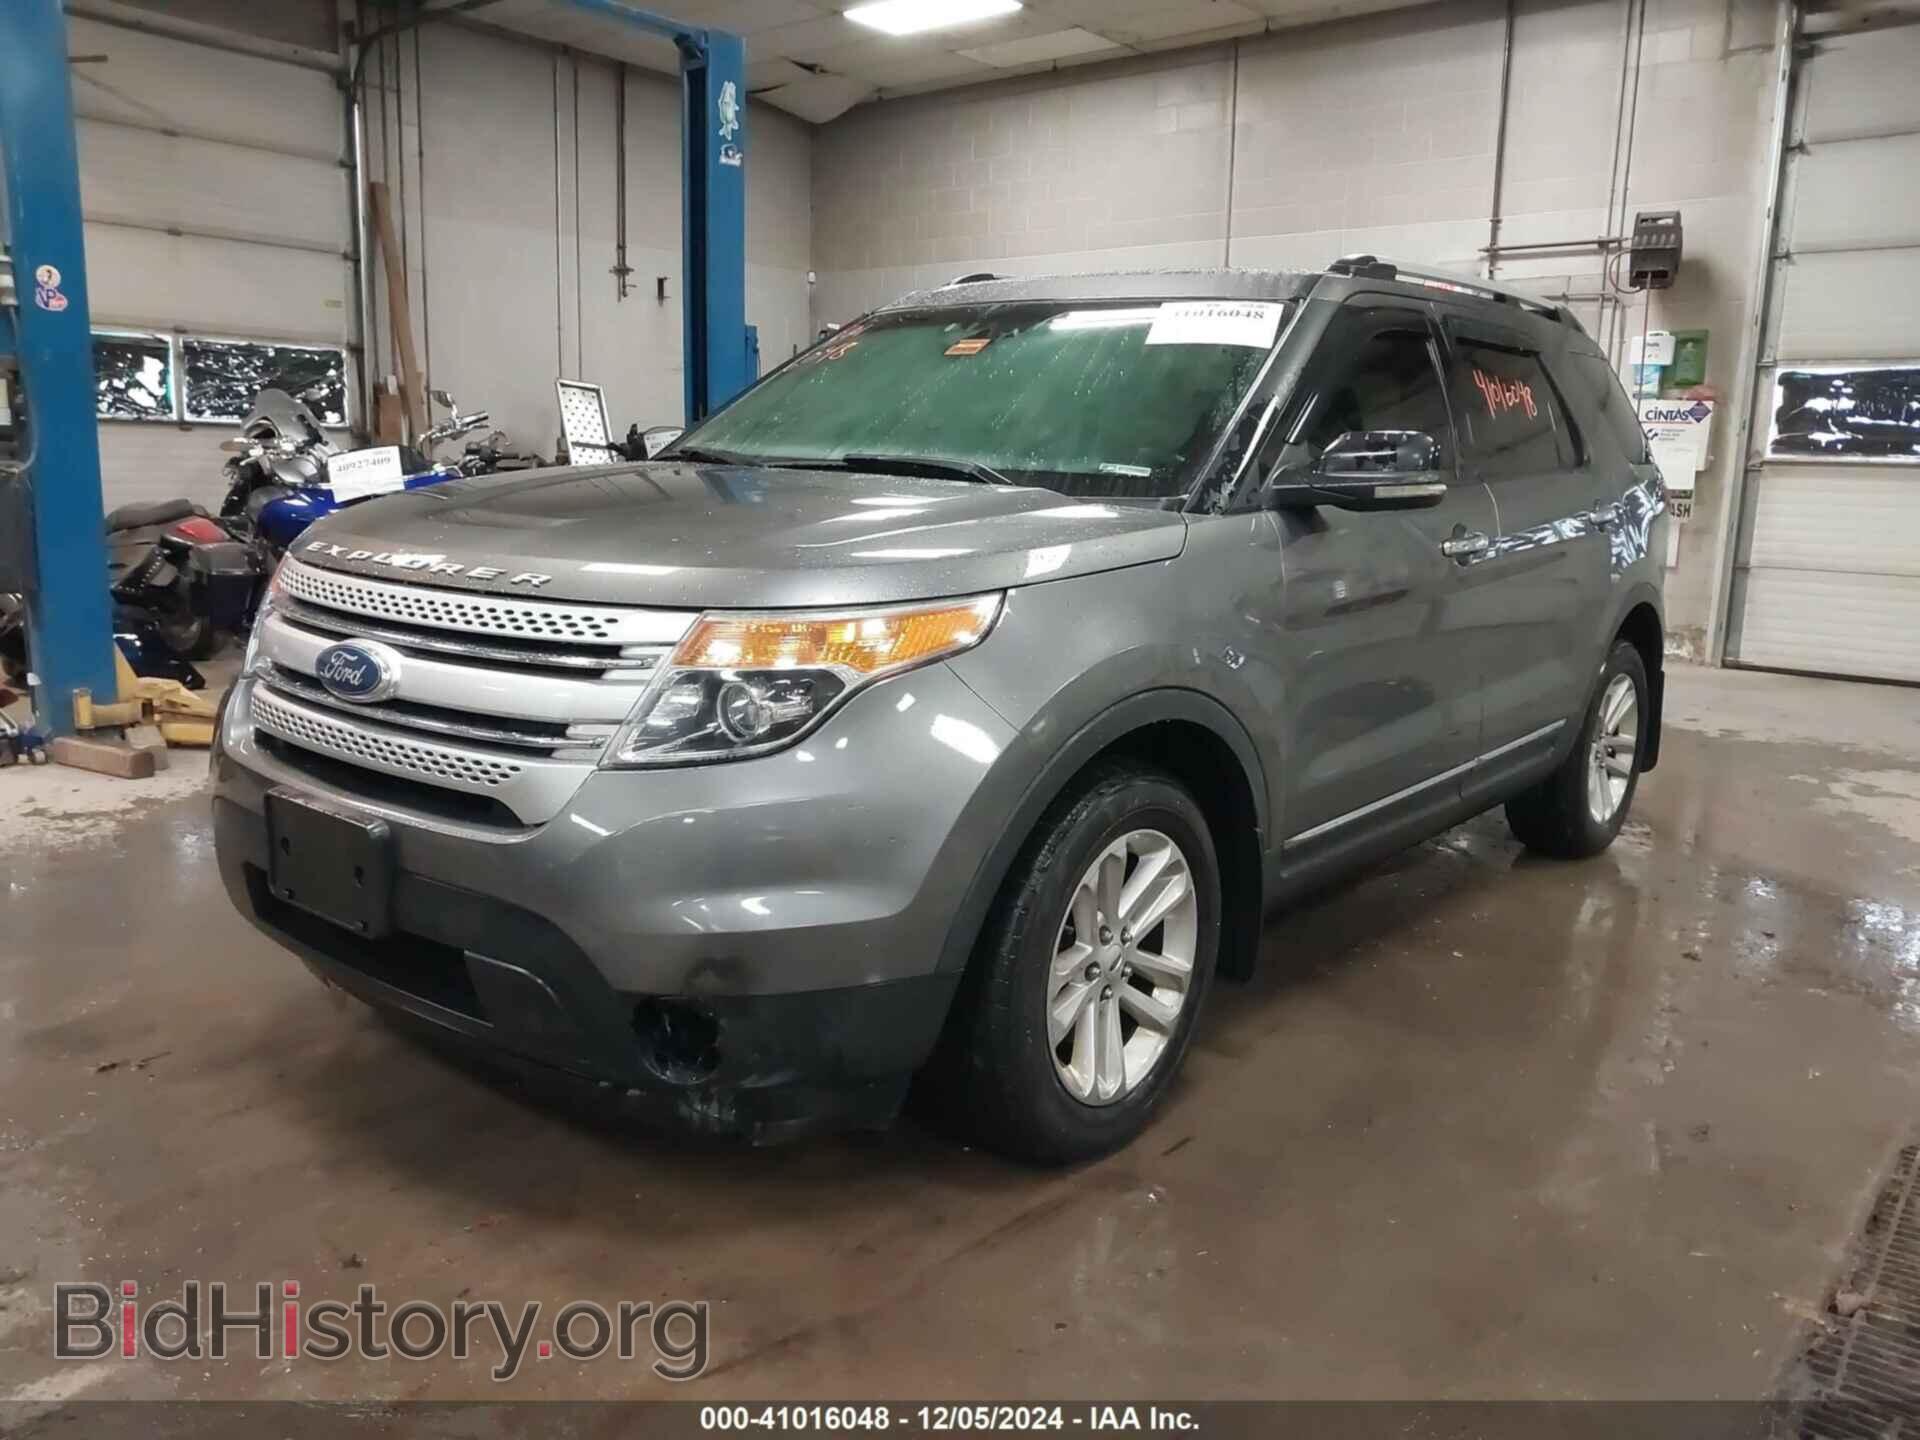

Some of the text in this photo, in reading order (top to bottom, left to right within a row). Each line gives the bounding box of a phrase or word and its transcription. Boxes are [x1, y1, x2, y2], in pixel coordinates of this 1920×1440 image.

[1472, 369, 1538, 419] 41016048
[306, 541, 553, 588] EXPLORER
[320, 650, 368, 687] Ford
